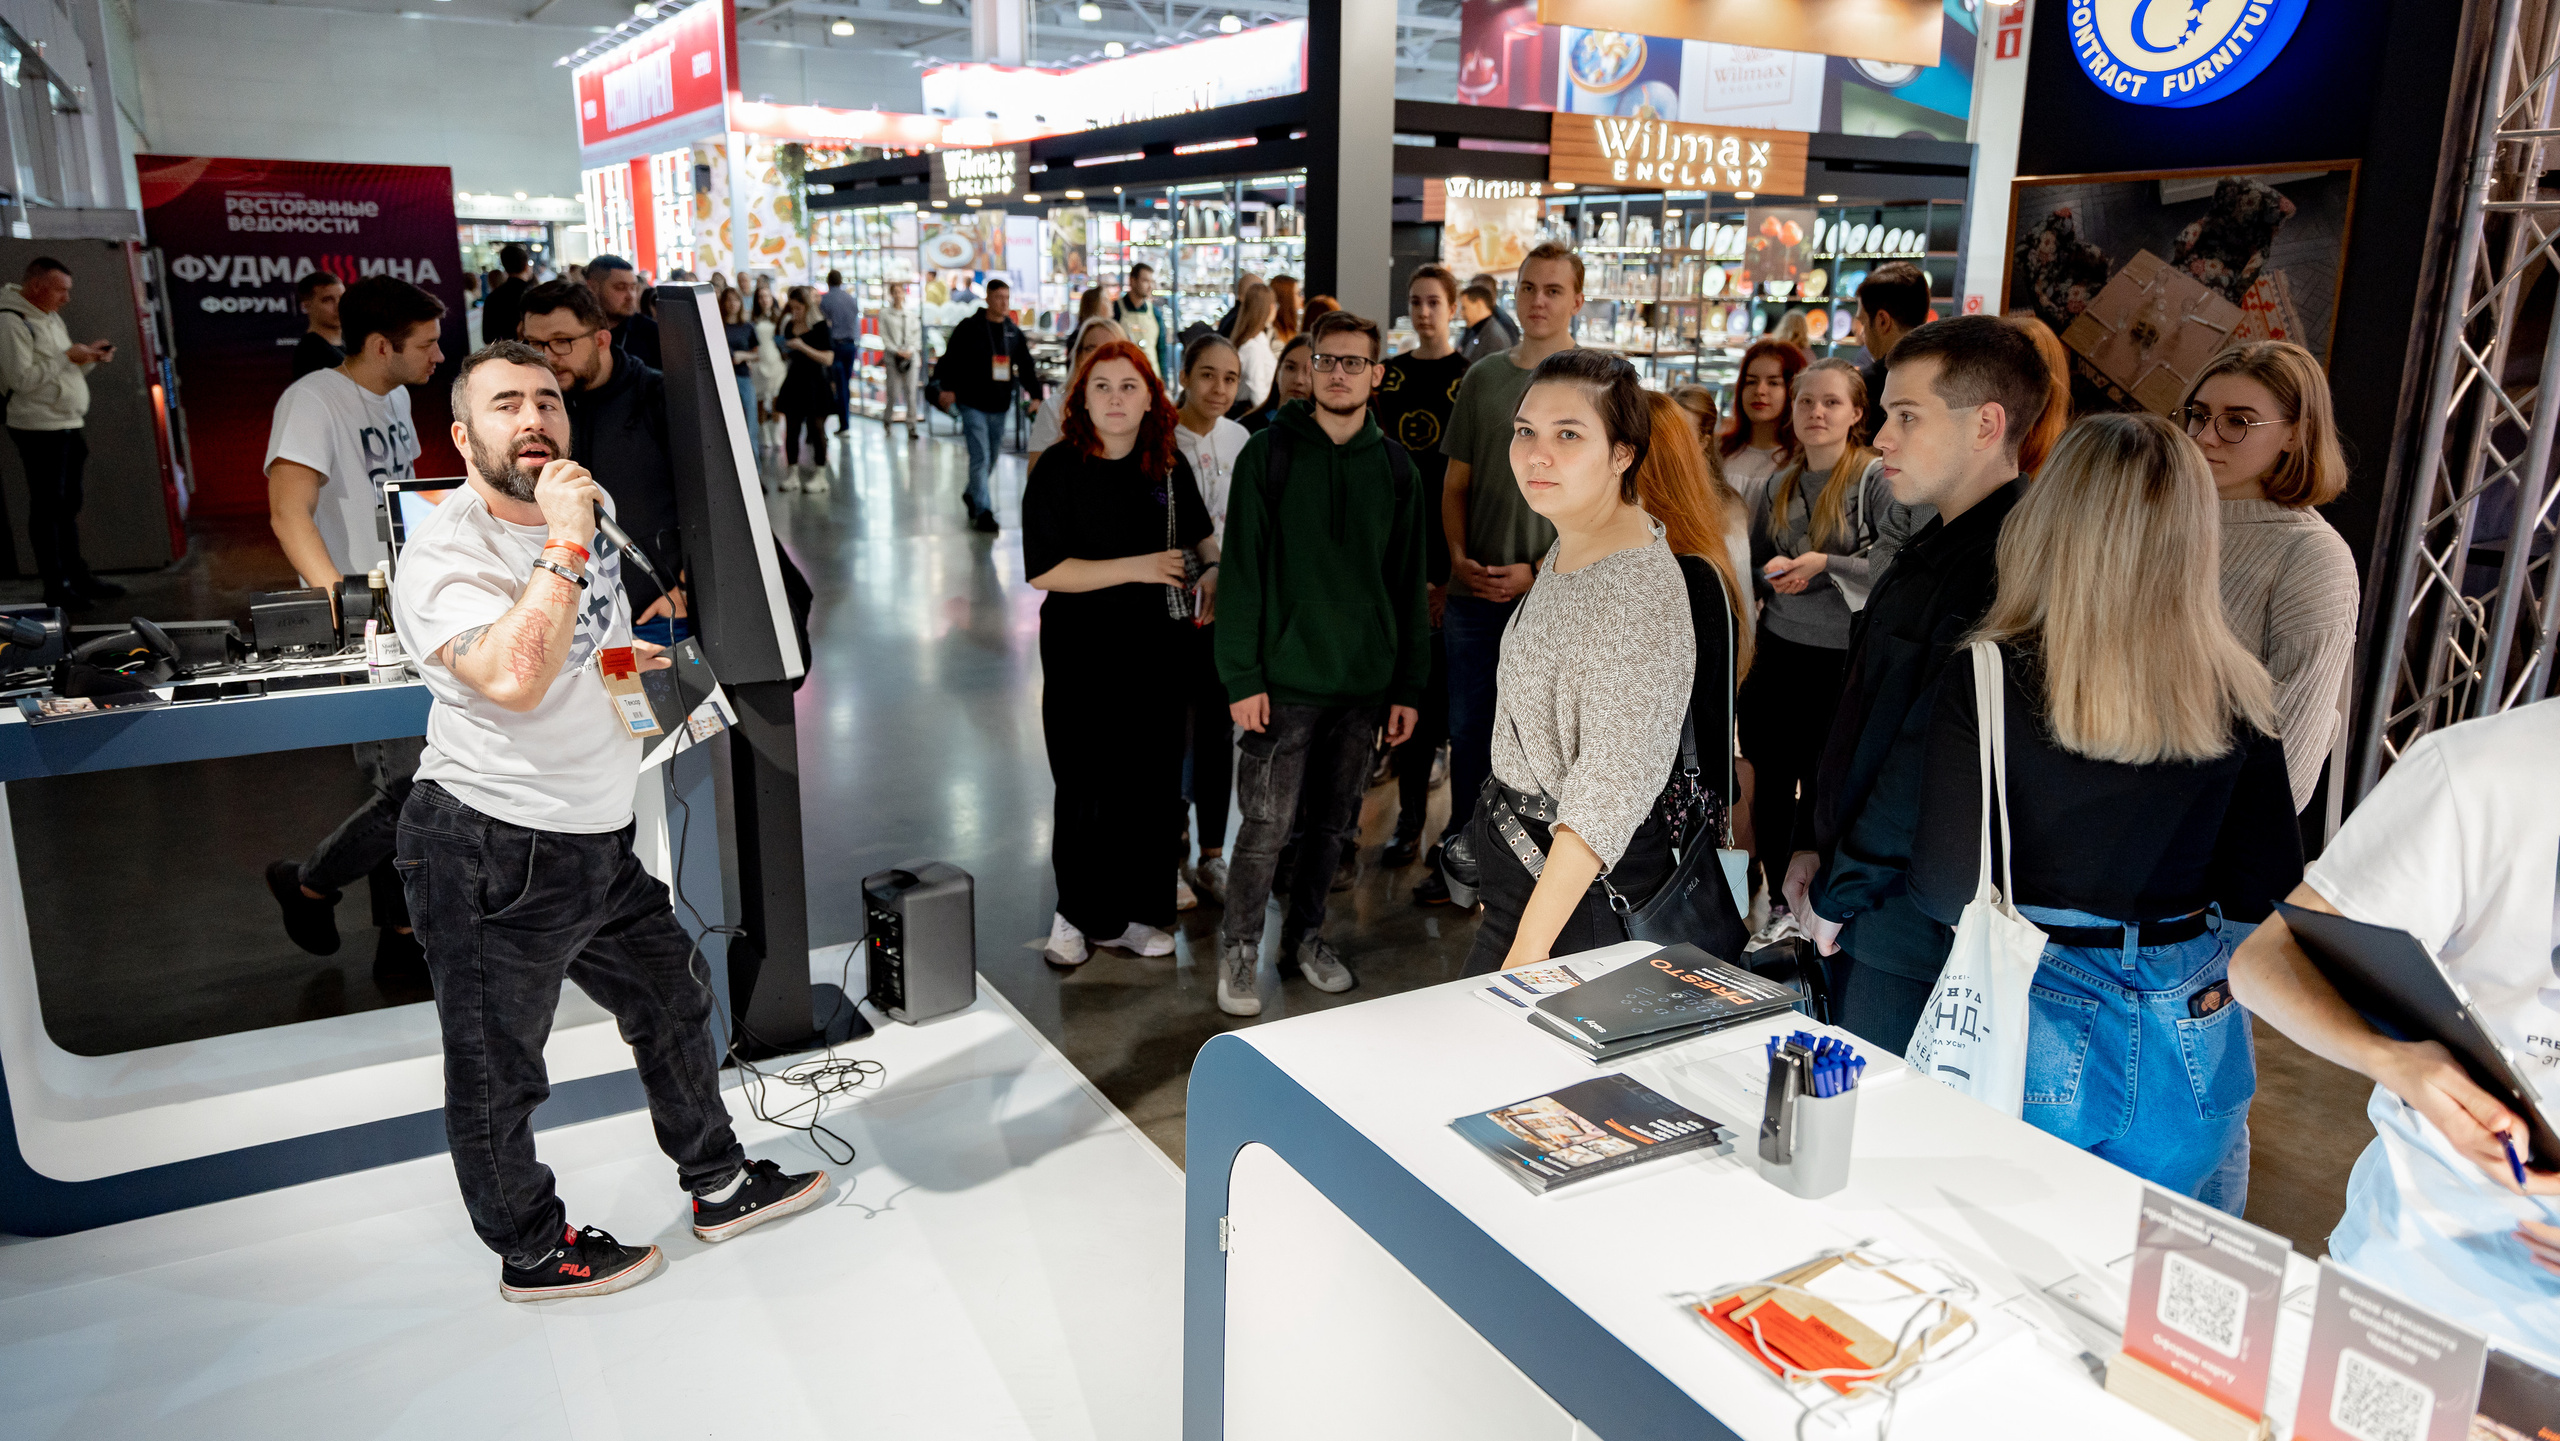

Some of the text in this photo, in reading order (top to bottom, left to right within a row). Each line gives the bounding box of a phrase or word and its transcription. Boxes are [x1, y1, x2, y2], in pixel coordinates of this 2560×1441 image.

[2163, 0, 2274, 97] FURNITU
[1714, 64, 1787, 84] Wilmax
[1594, 118, 1771, 168] Wilmax
[942, 148, 1016, 181] Wilmax
[1613, 160, 1763, 188] ENGLAND
[1444, 178, 1542, 200] Wilmax
[200, 297, 288, 314] ФОРУМ
[1649, 959, 1755, 1006] PRESTO
[558, 1263, 591, 1278] FILA
